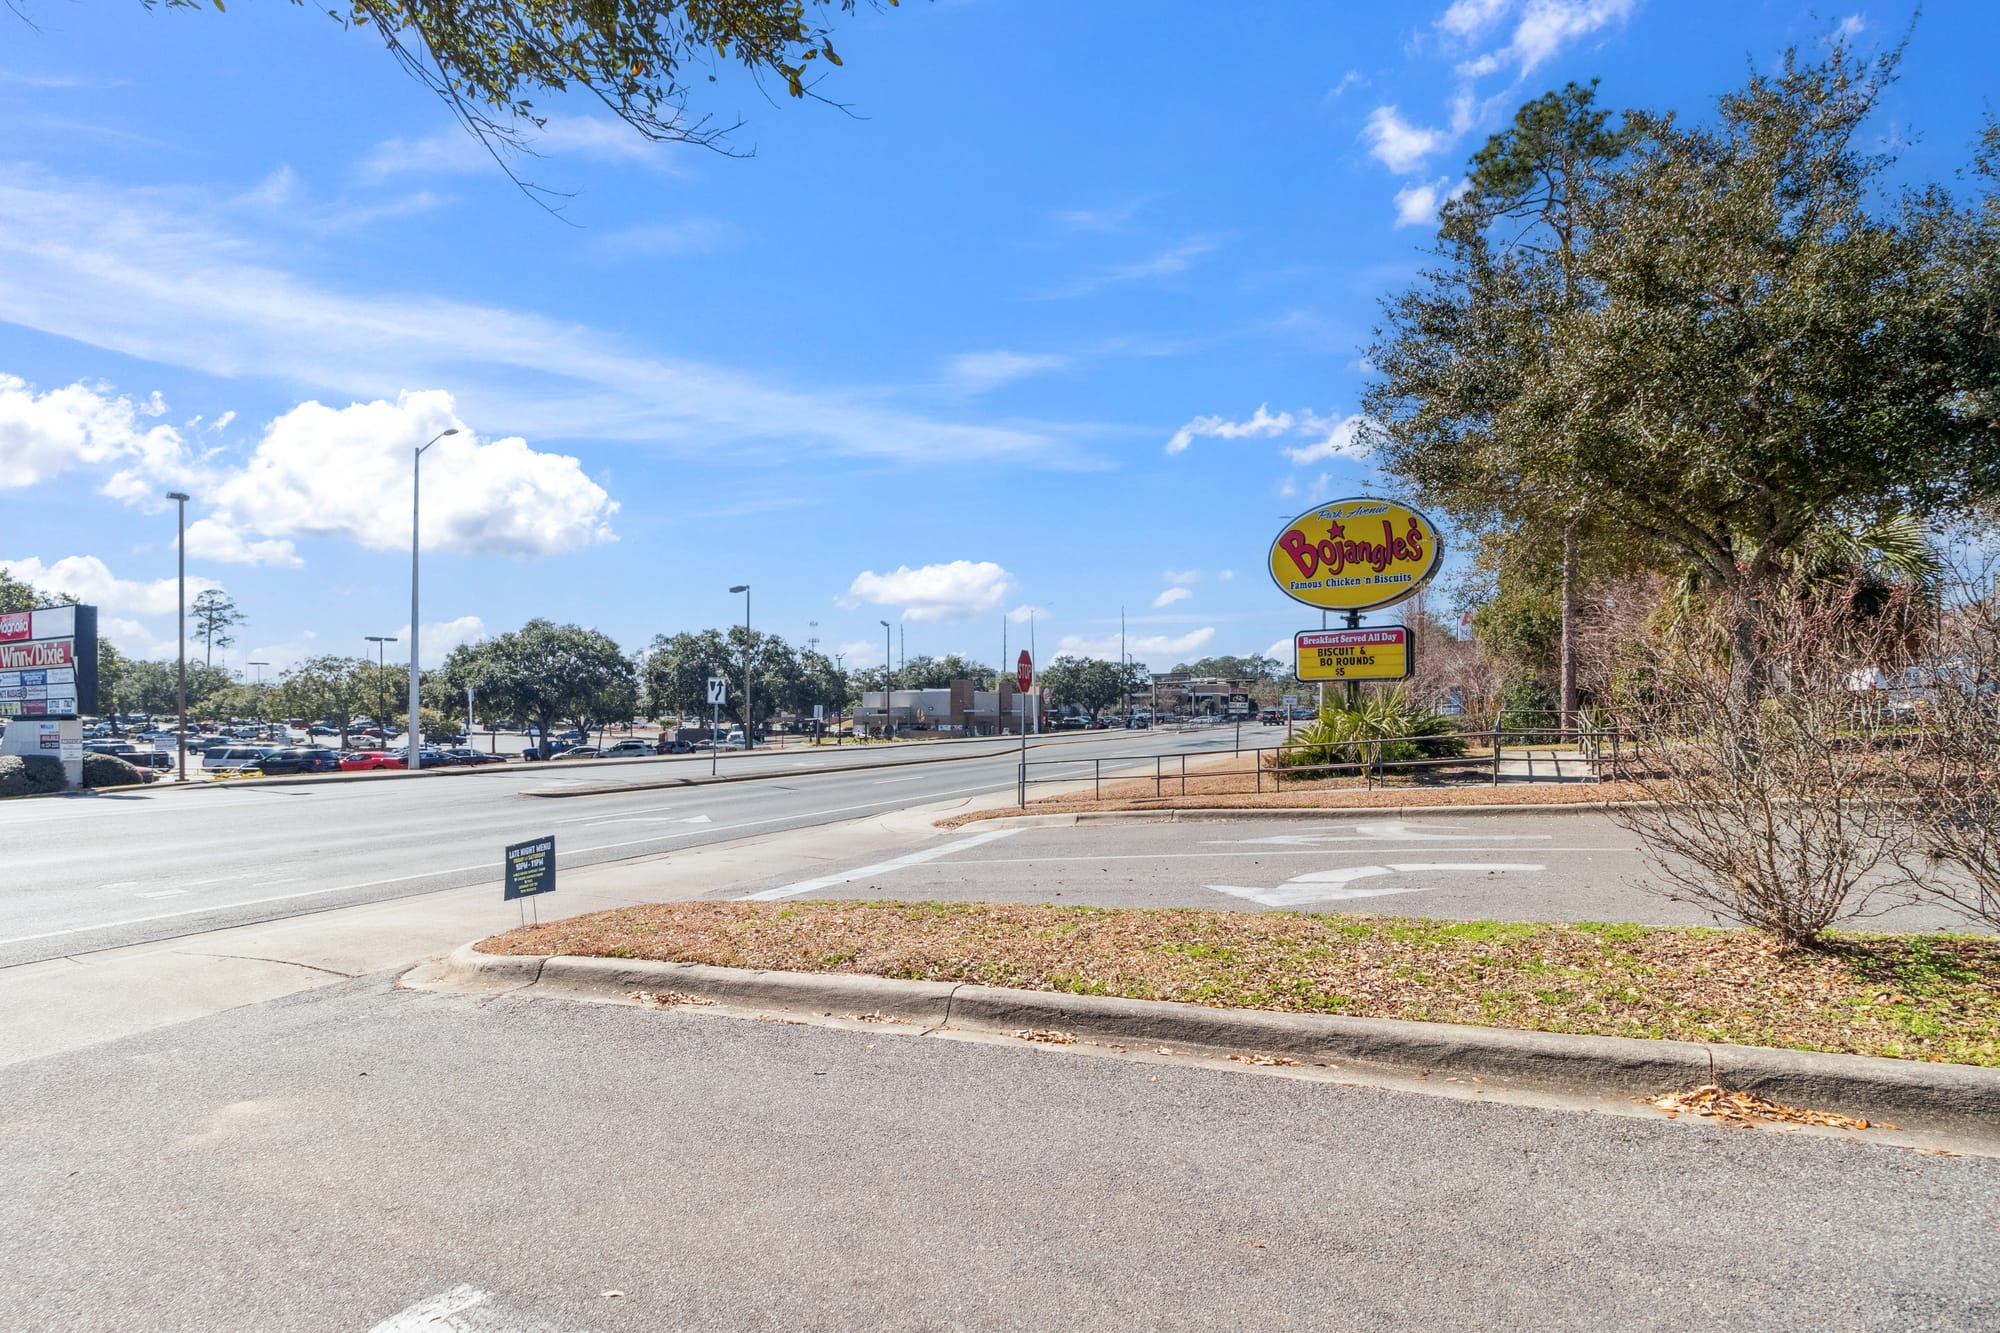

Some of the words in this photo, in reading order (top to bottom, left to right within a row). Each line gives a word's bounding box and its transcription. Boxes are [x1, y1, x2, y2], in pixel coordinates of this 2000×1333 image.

[1317, 509, 1343, 521] Park
[1345, 505, 1389, 518] Avenue
[1290, 580, 1322, 590] Famous
[1325, 577, 1361, 588] Chicken
[1374, 573, 1412, 584] Biscuits
[1303, 635, 1339, 645] Breakfast
[1340, 634, 1367, 643] Served
[1368, 633, 1380, 642] All
[1382, 633, 1397, 642] Day
[1317, 647, 1355, 657] BISCUIT
[1360, 646, 1366, 655] &
[1320, 658, 1333, 667] BO
[1336, 656, 1375, 666] ROUNDS
[1018, 663, 1032, 680] STOP
[1335, 667, 1345, 676] $5
[509, 849, 520, 860] LATE
[520, 845, 535, 856] NIGHT
[536, 842, 551, 852] MENU
